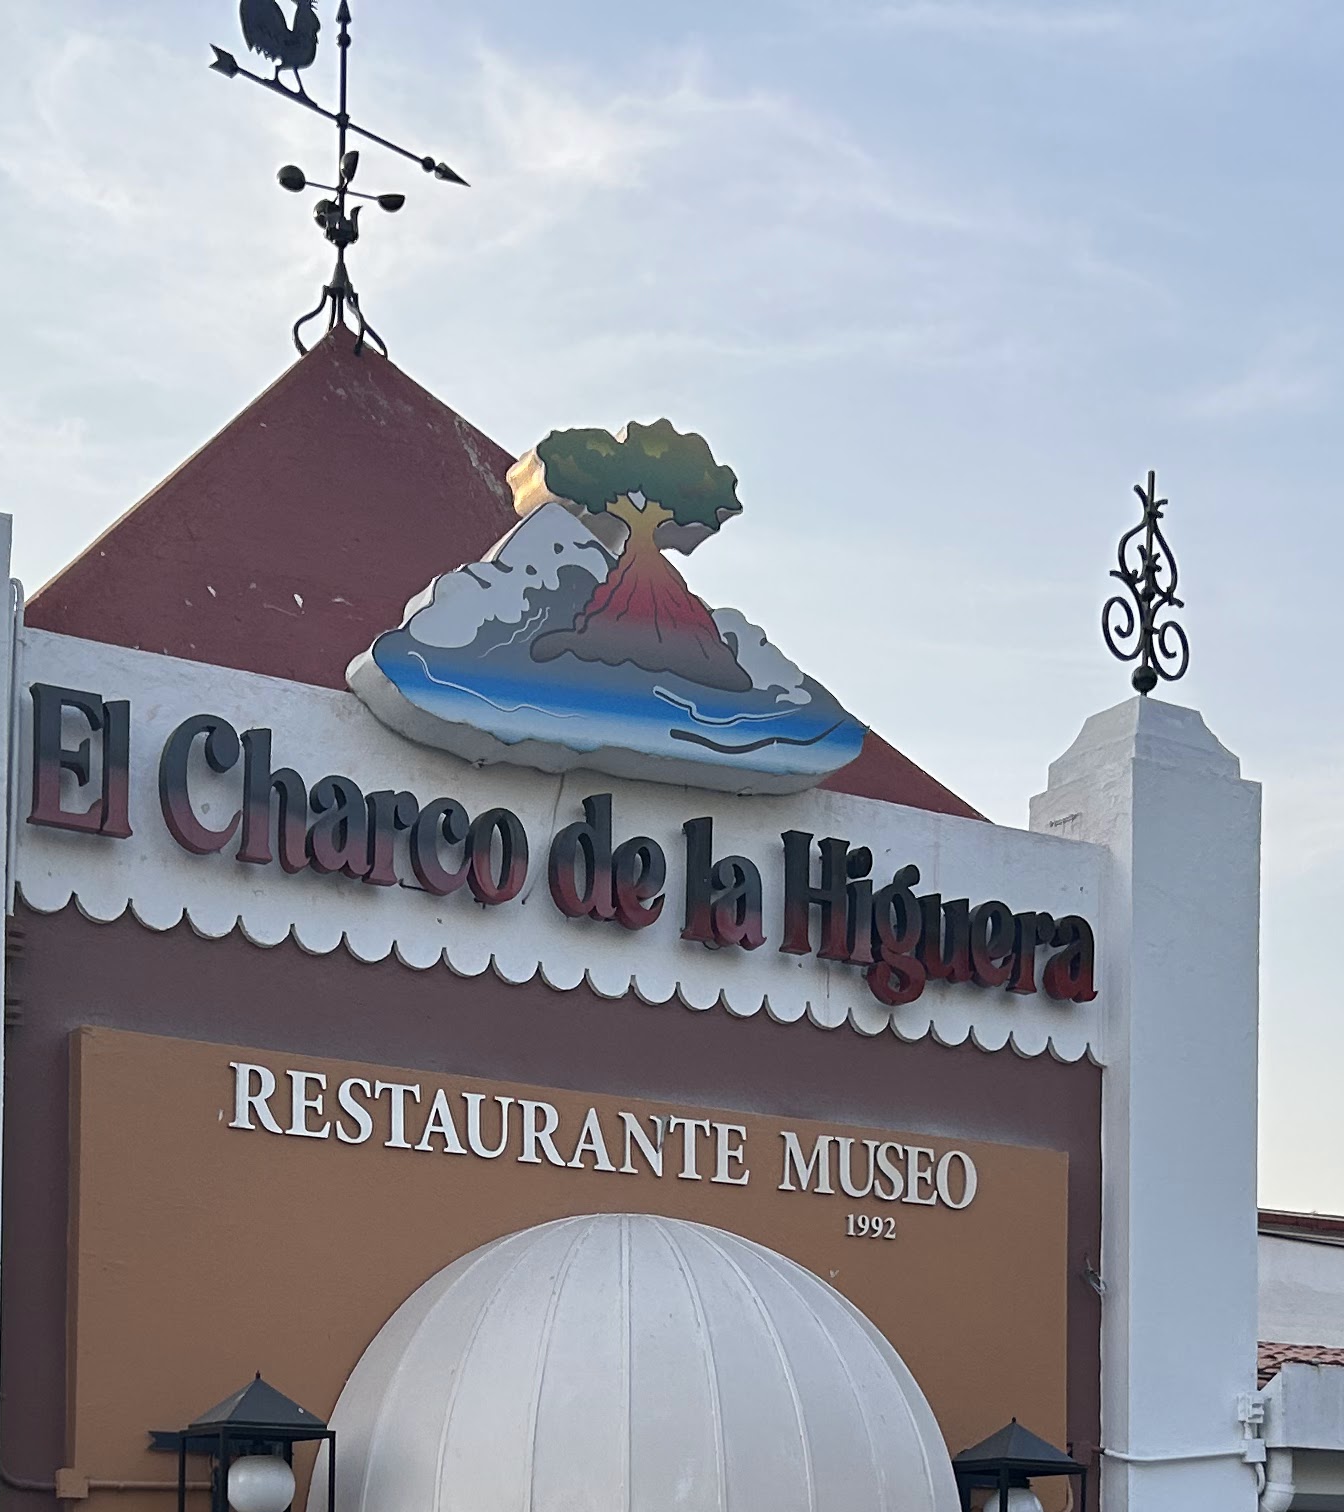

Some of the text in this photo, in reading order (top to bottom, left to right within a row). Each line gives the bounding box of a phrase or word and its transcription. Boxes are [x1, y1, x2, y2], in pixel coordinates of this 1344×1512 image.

[26, 682, 1099, 1004] El Charco de la Higuera
[228, 1060, 979, 1211] RESTAURANTE MUSEO
[844, 1213, 897, 1241] 1992
